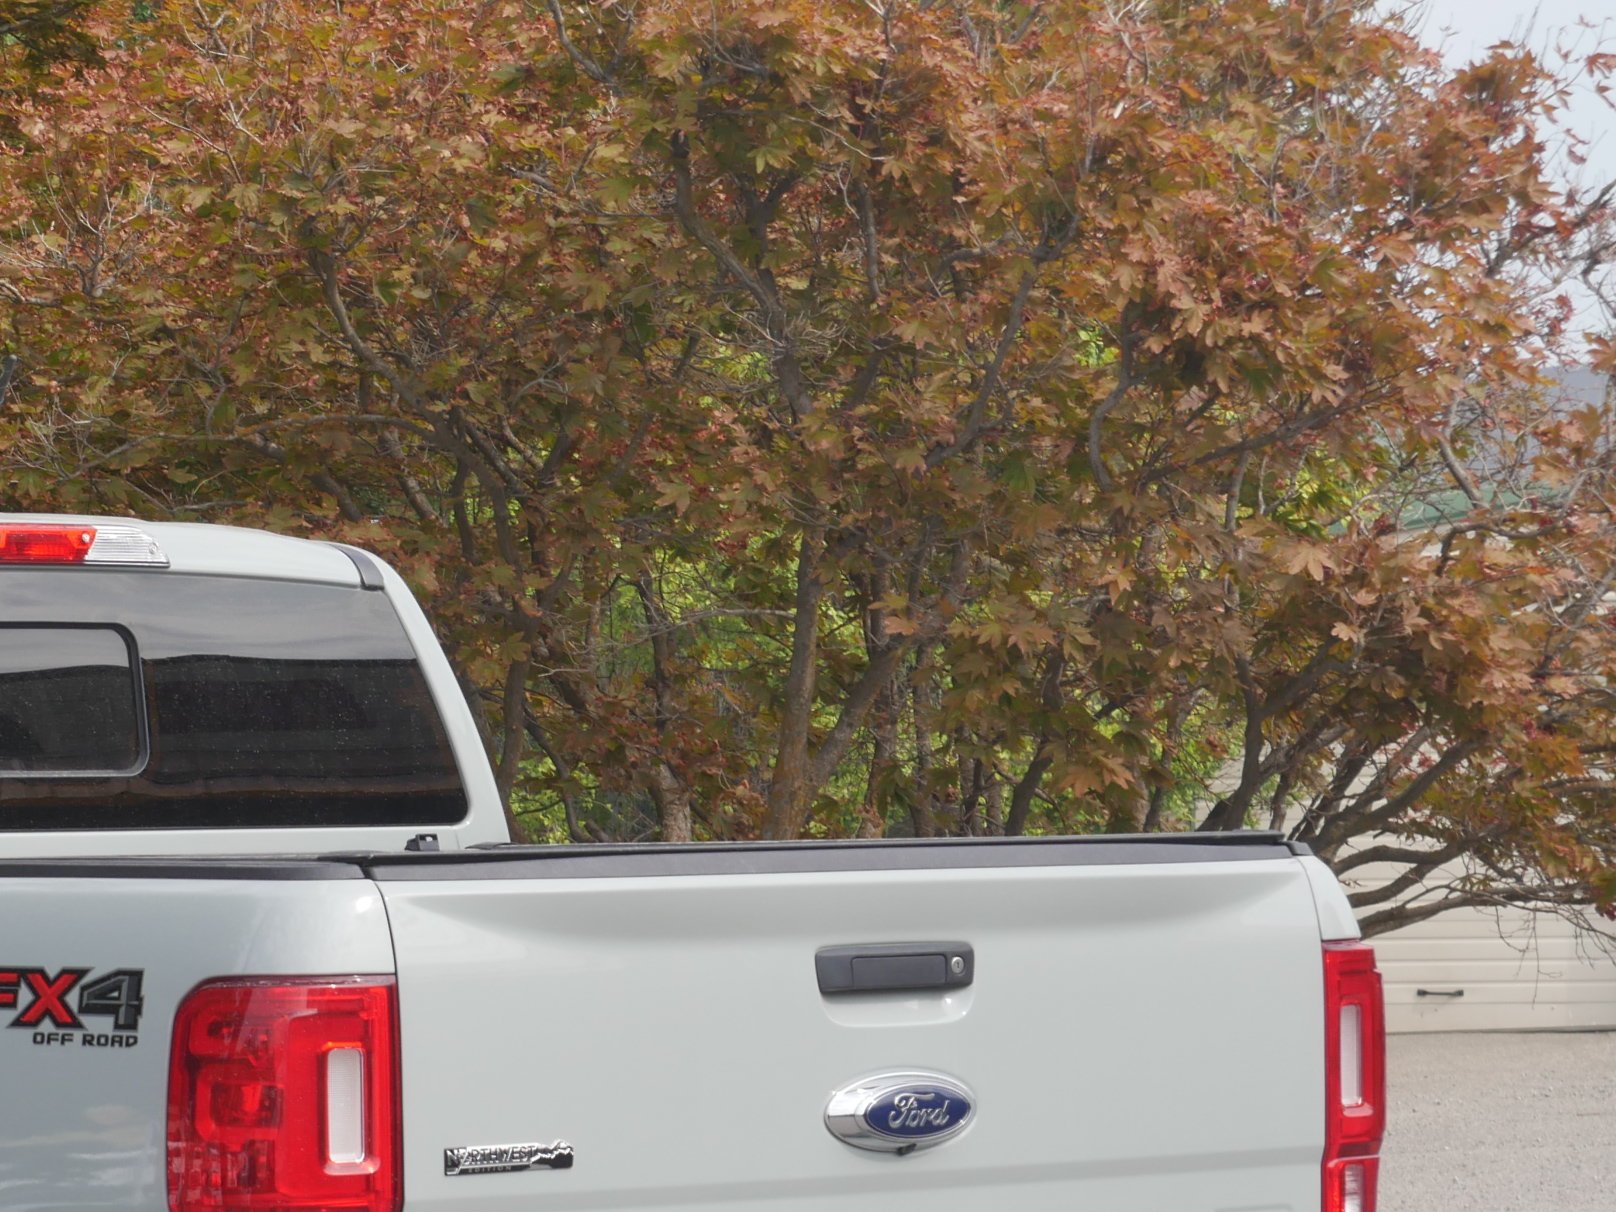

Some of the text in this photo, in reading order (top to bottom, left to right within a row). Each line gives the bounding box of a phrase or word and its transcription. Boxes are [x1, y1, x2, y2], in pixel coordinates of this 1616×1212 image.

[32, 1031, 138, 1048] OFF ROAD
[887, 1092, 952, 1129] Ford
